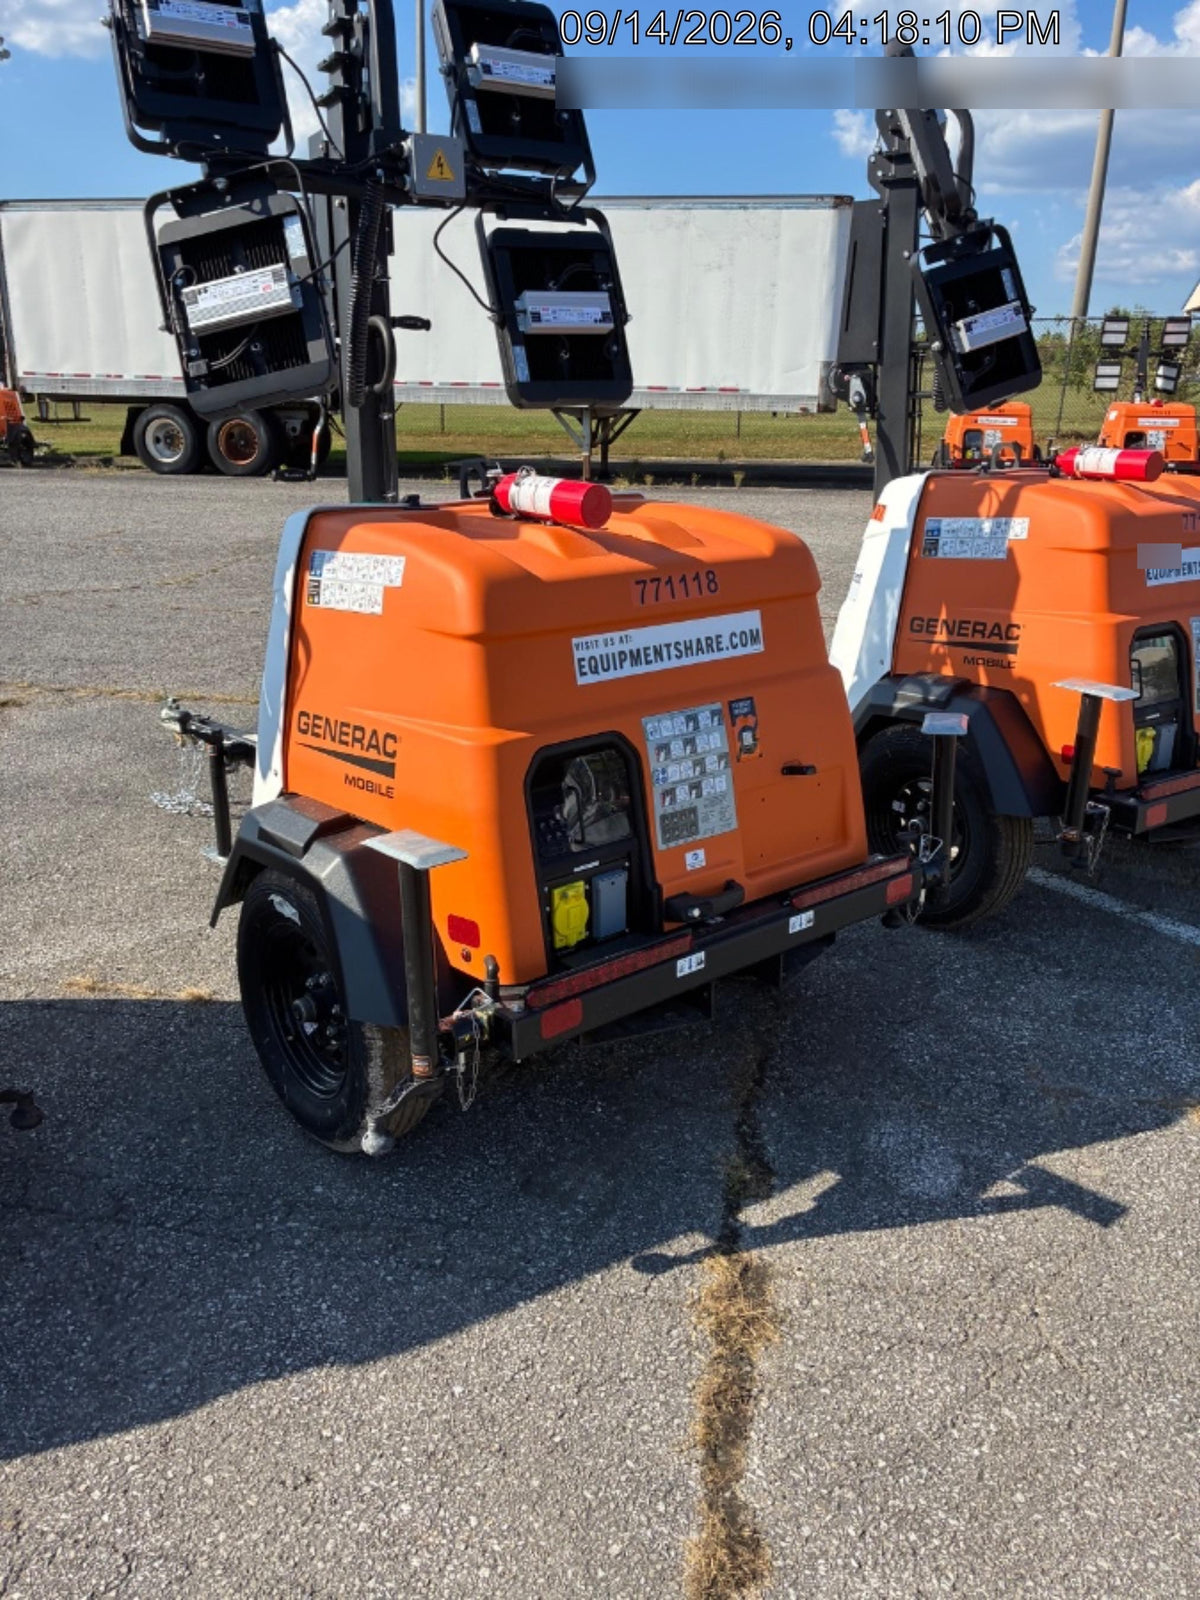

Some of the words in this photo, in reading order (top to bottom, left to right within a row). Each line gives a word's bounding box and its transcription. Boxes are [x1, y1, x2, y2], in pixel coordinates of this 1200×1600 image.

[1182, 513, 1200, 530] 77
[635, 570, 719, 605] 771118
[910, 616, 1021, 641] GENERAC
[574, 639, 599, 651] VISIT
[602, 637, 615, 648] US
[618, 634, 632, 645] AT:
[577, 628, 761, 677] EQUIPMENTSHARE.COM
[963, 656, 1016, 669] MOBILE
[297, 710, 398, 759] GENERAC
[344, 773, 395, 799] MOBILE
